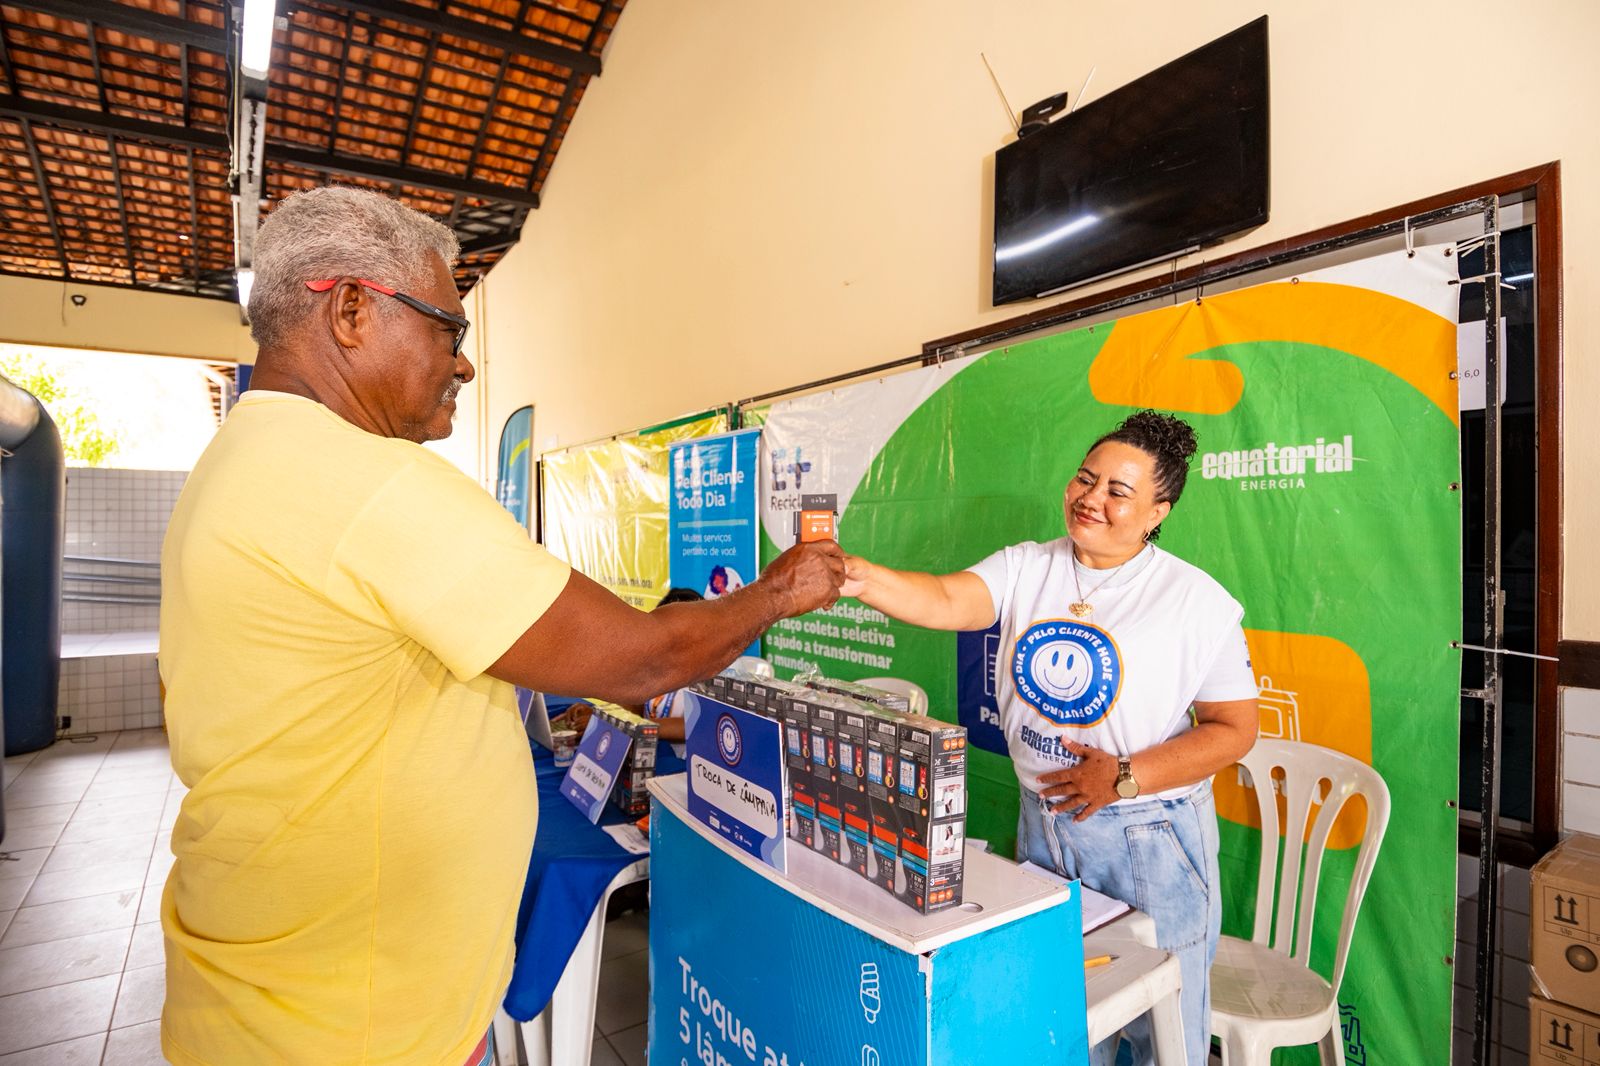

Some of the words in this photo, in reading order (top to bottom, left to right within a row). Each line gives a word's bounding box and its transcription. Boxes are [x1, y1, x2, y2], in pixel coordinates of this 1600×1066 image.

[1201, 435, 1353, 480] equatorial
[1241, 478, 1306, 491] ENERGIA
[706, 490, 726, 507] Dia
[771, 494, 802, 511] Recicl
[803, 620, 840, 638] coleta
[841, 626, 895, 648] seletiva
[766, 634, 773, 645] e
[773, 633, 803, 651] ajudo
[804, 641, 812, 654] a
[812, 640, 893, 669] transformar
[1015, 653, 1026, 674] DIA
[1027, 627, 1056, 645] PELO
[1058, 626, 1103, 648] CLIENTE
[1097, 646, 1113, 682] HOJE
[1018, 676, 1042, 704] TODO
[1084, 690, 1107, 716] PELO
[980, 705, 1000, 727] Pa
[1041, 702, 1086, 719] FUTURO
[1036, 752, 1076, 769] ENERGIA
[696, 763, 722, 788] TROCA
[726, 779, 736, 796] DE
[679, 956, 757, 1061] Troque
[763, 1045, 804, 1066] at
[679, 1006, 691, 1045] 5
